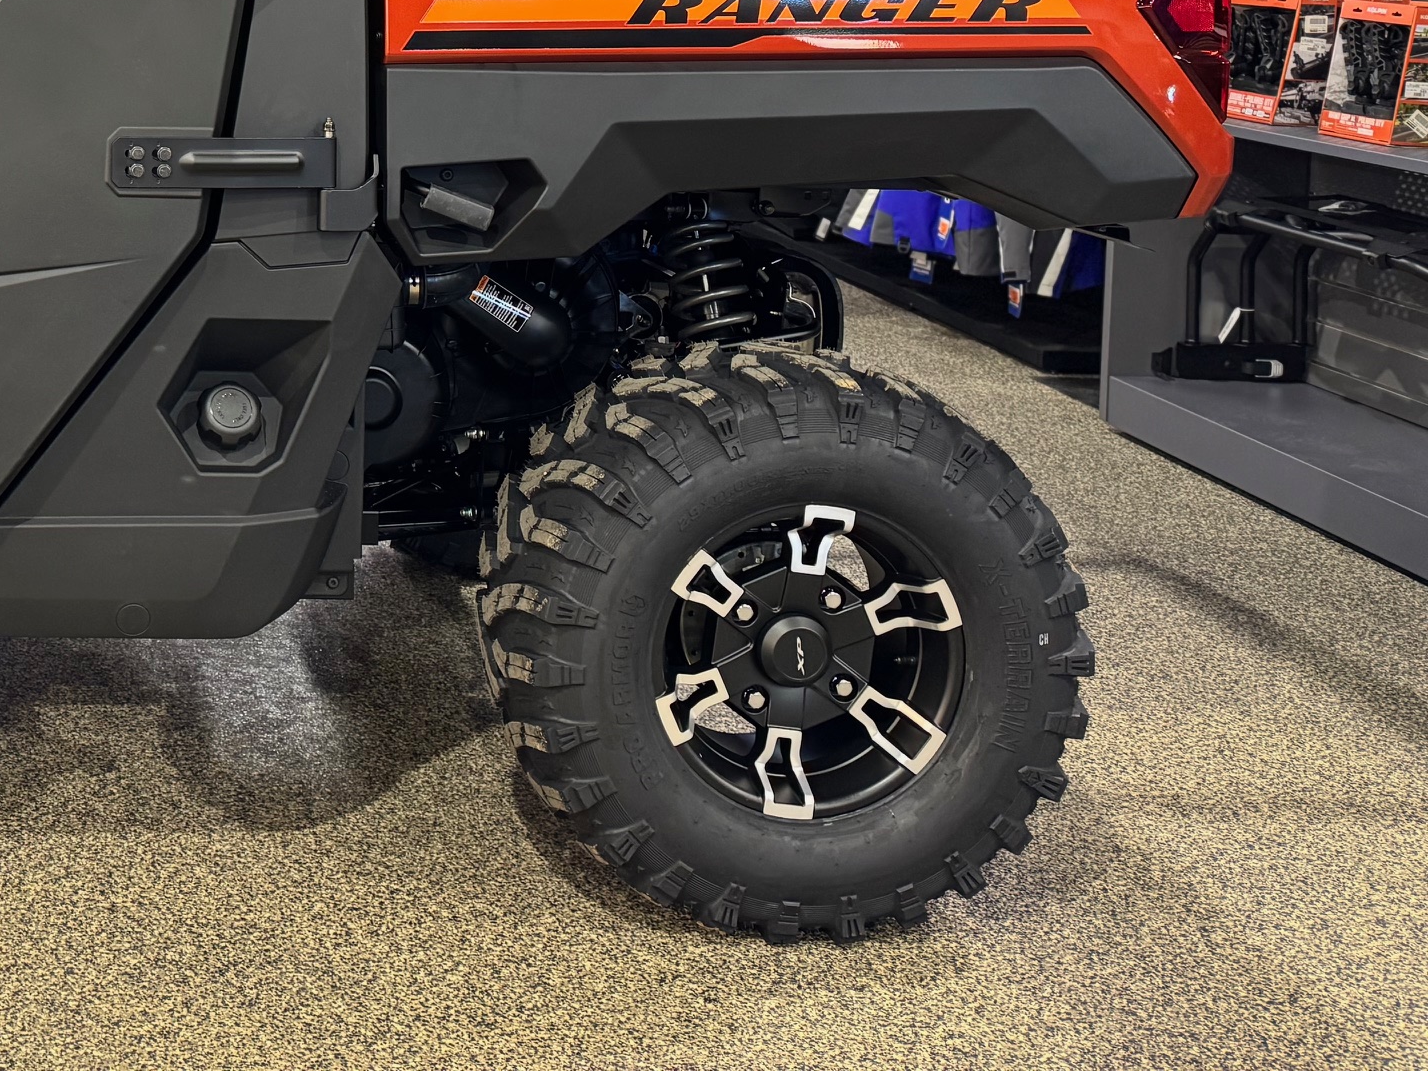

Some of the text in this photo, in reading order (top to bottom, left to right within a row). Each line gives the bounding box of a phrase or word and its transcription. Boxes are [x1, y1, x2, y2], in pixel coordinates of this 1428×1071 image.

[796, 636, 805, 676] XP
[978, 558, 1033, 754] X-TERRAIN
[1038, 632, 1049, 646] CH
